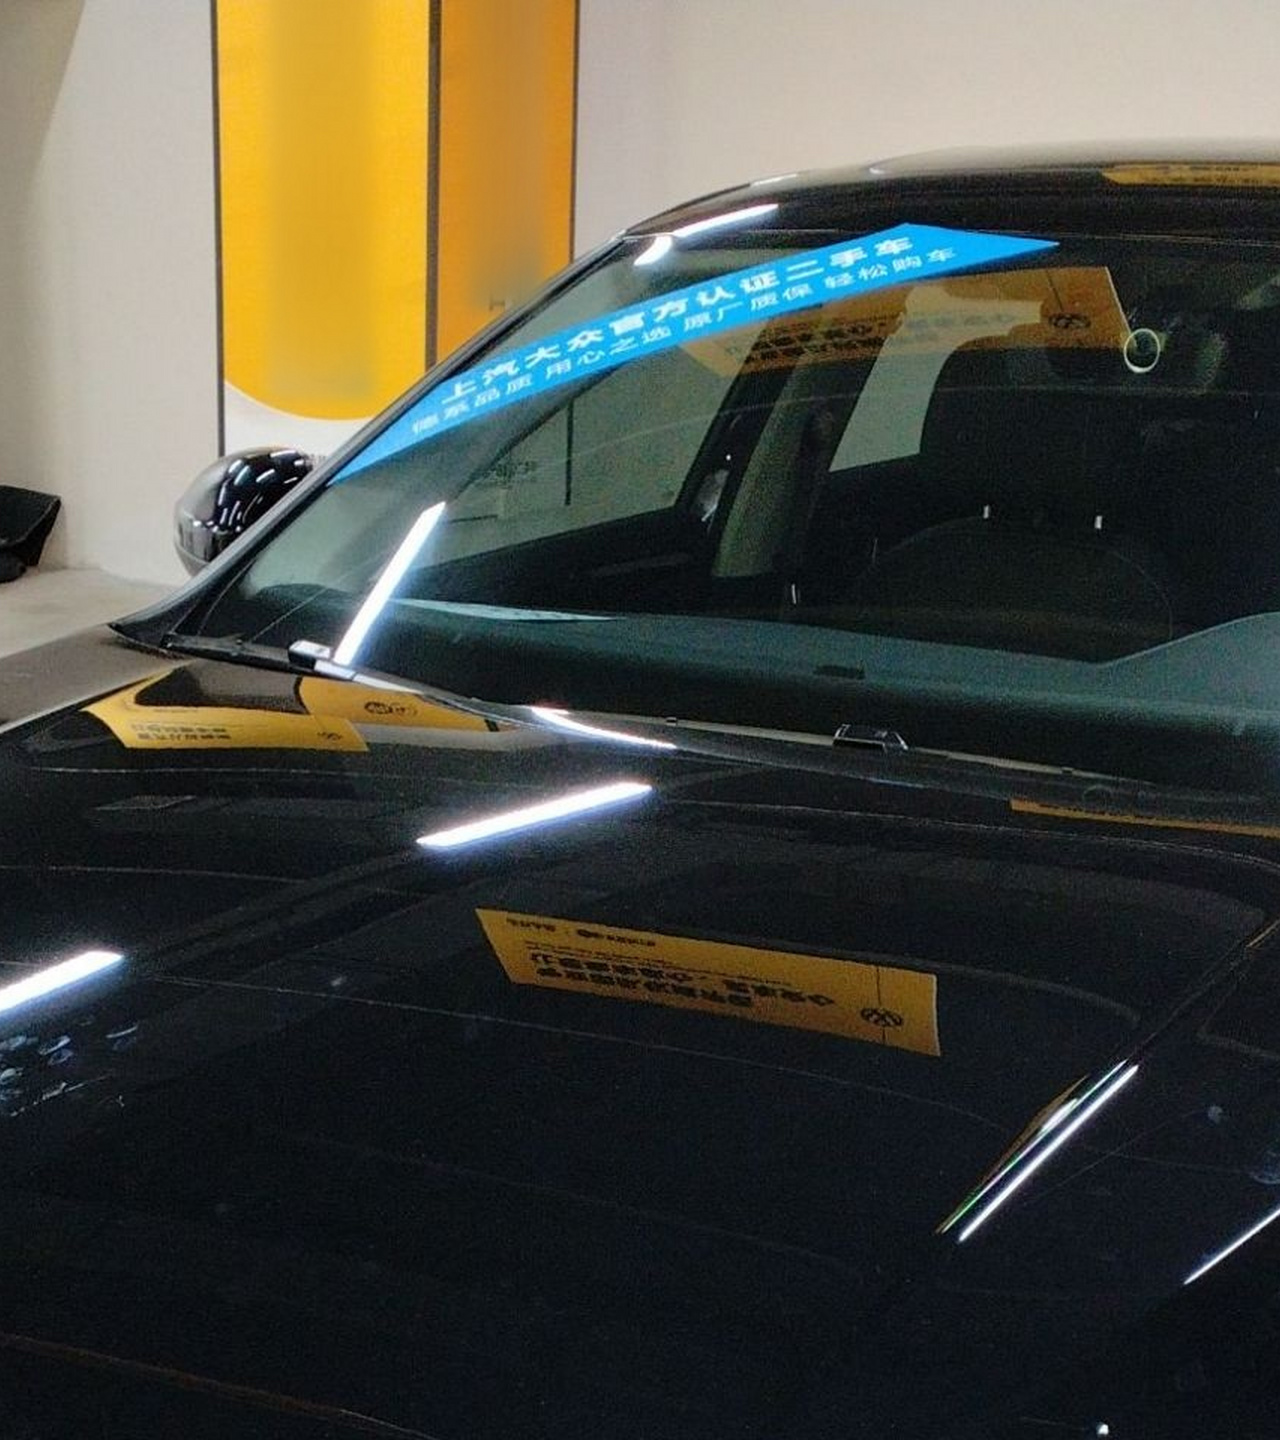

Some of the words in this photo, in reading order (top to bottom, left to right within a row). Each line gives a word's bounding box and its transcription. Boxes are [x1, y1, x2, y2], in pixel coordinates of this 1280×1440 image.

[440, 236, 915, 406] 上汽大众官方认证二手车
[545, 326, 671, 380] 用心之选
[683, 282, 813, 331] 原厂质保
[824, 246, 956, 288] 轻松购车
